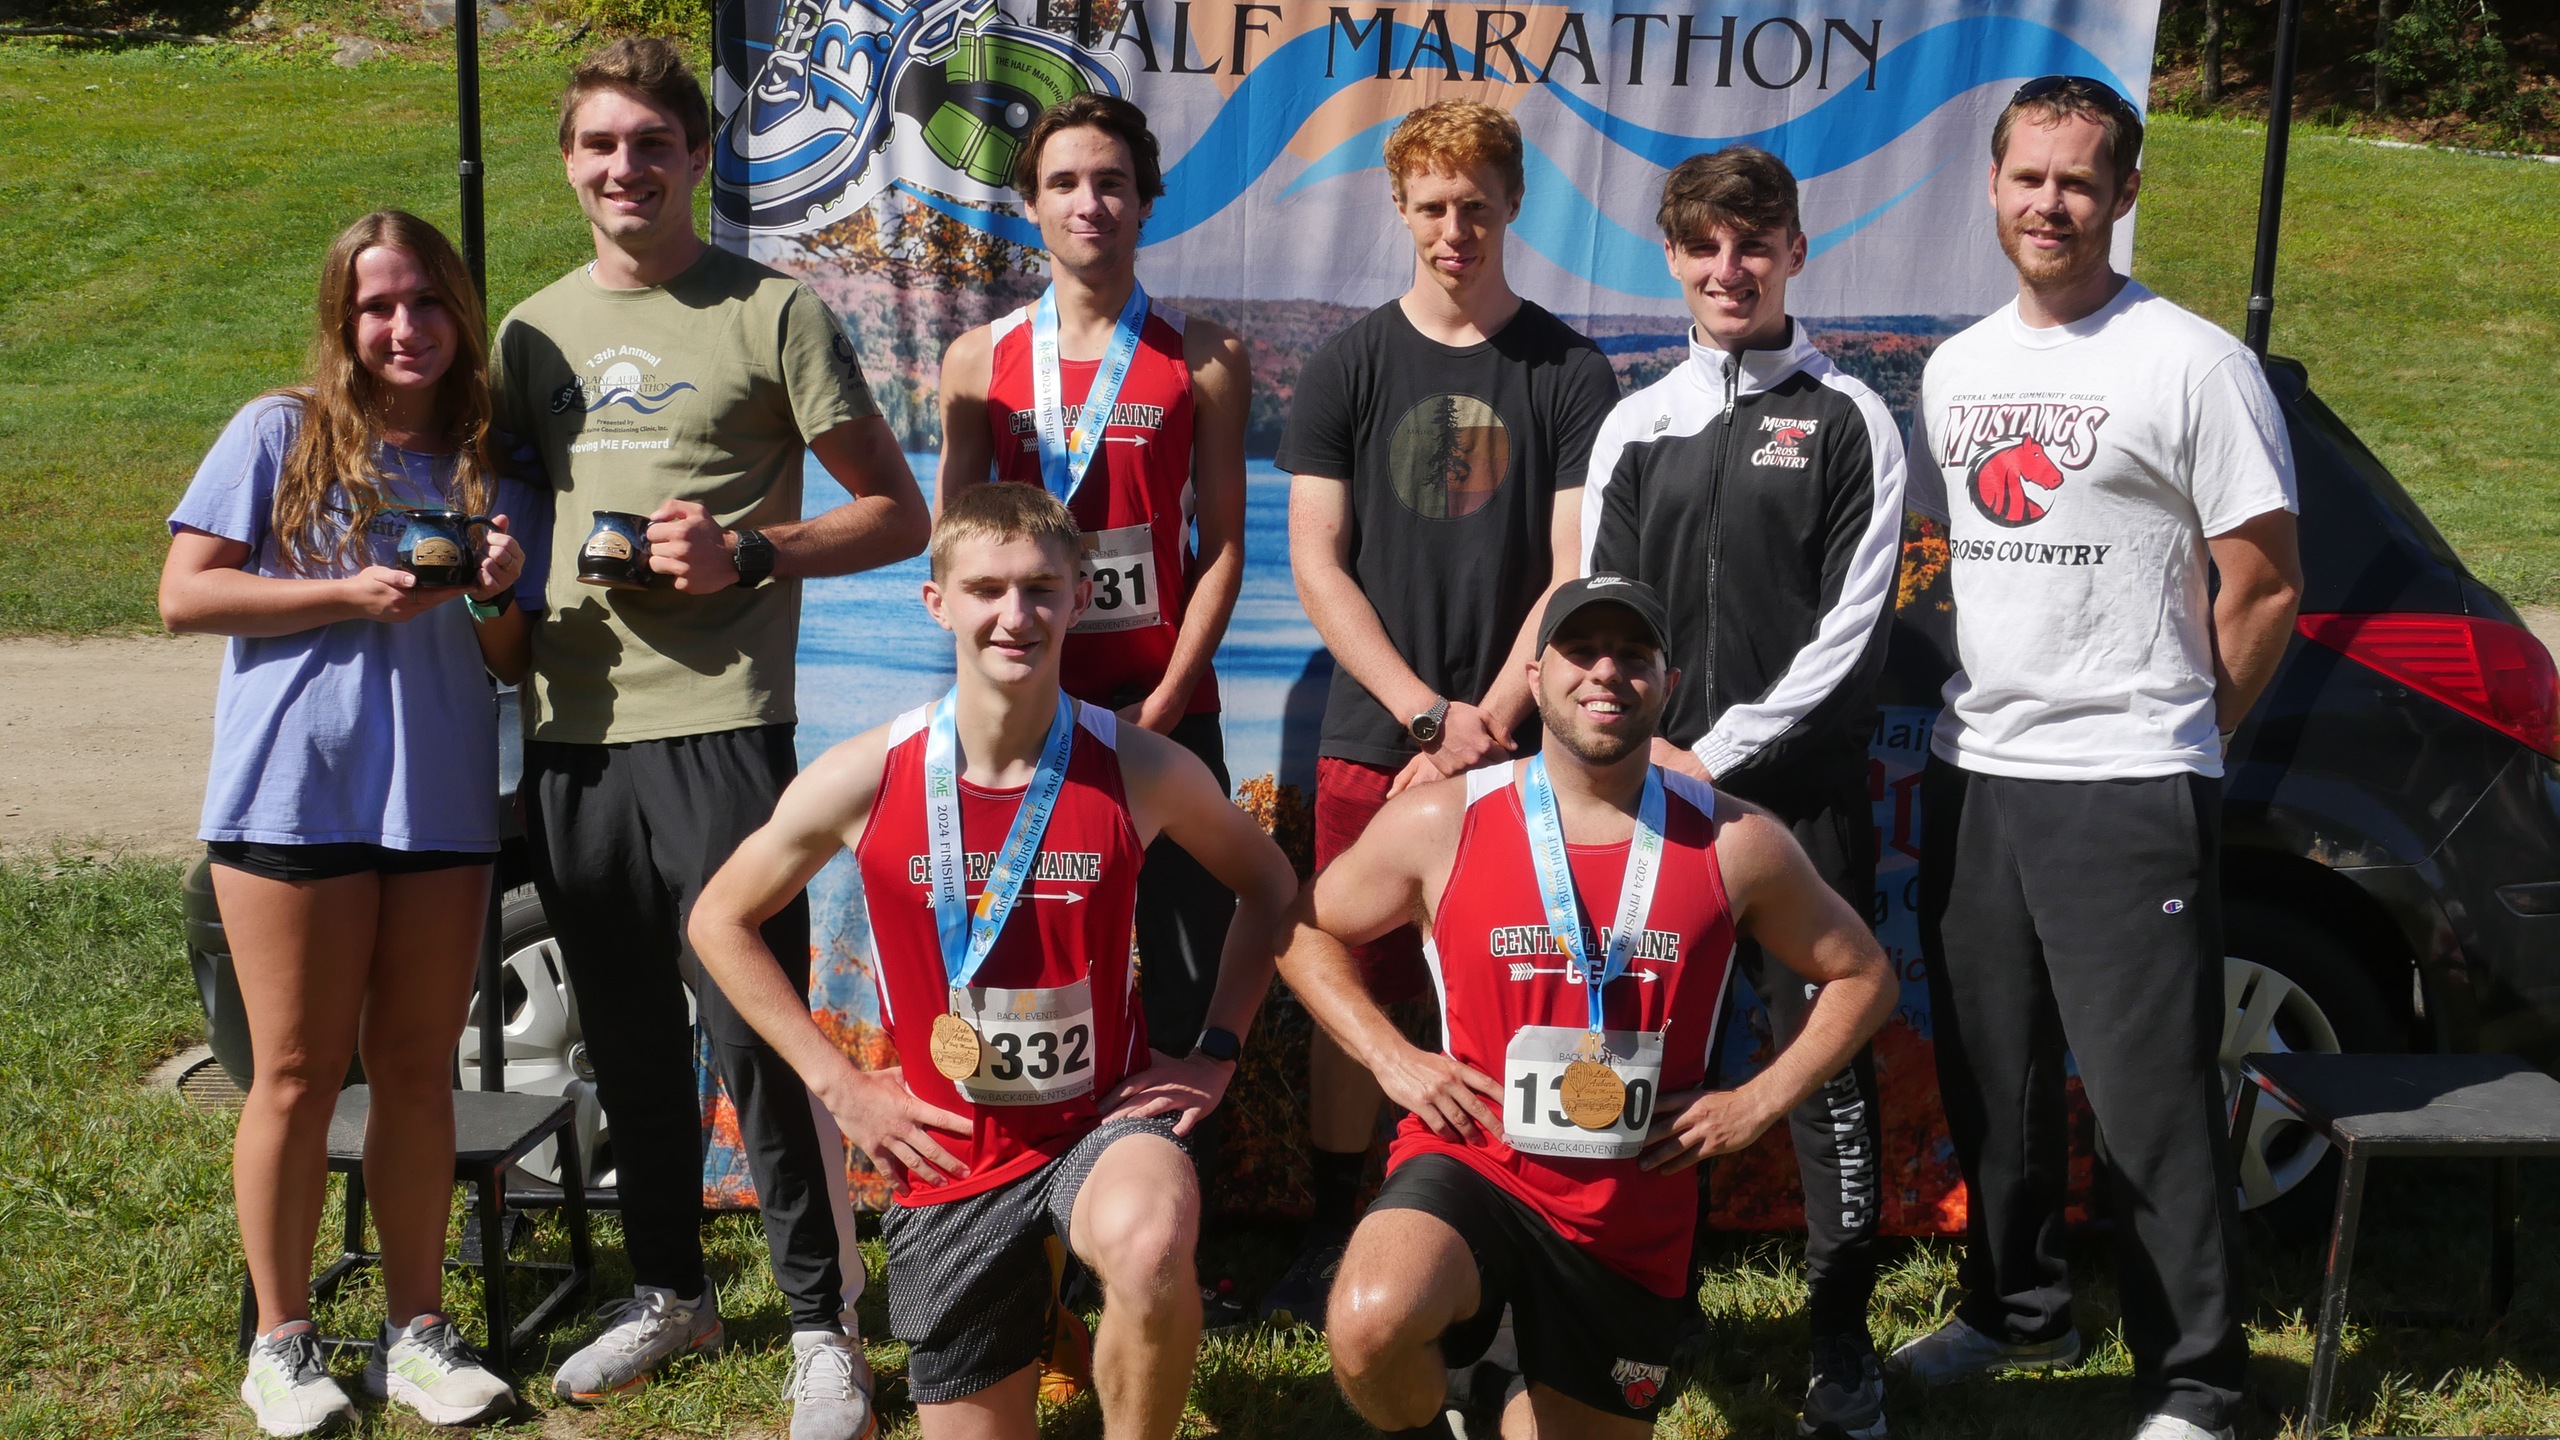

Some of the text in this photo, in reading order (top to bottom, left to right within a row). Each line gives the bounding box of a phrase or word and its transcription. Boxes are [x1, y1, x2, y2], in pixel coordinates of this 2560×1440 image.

[1036, 0, 1883, 91] HALF MARATHON
[995, 56, 1064, 102] THE HALF MARATHO
[585, 344, 662, 369] 13th Annual
[1093, 385, 1116, 426] AUBURN
[1109, 361, 1126, 386] HALF
[1120, 311, 1143, 359] MARATHON
[1041, 368, 1056, 445] 2024 FINISHER
[1952, 394, 1987, 402] CENTRAL
[1990, 392, 2016, 400] MAINE
[2069, 393, 2107, 402] COLLEGE
[601, 426, 639, 434] Conditioning
[1757, 415, 1819, 436] MUSTANGS
[1941, 403, 2111, 471] MUSTANGS
[567, 438, 670, 454] Moving ME Forward
[1764, 441, 1799, 456] CROSS
[1750, 449, 1809, 469] COUNTRY
[1090, 549, 1119, 558] EVENTS
[1950, 539, 2112, 566] ROSS COUNTRY
[1081, 562, 1147, 611] 31
[935, 775, 949, 798] ME
[991, 733, 1071, 924] LAKE AUBURN HALF MARATHON
[1006, 799, 1037, 860] Annual
[937, 804, 955, 904] 2024 FINISHER
[1641, 832, 1656, 855] ME
[1536, 768, 1583, 957] LAKE AUBURN HALF MARATHON
[1616, 858, 1649, 953] 2024 FINISHER
[997, 1010, 1059, 1021] BACK EVENTS
[955, 1025, 970, 1034] Lake
[1559, 1052, 1583, 1061] BACK
[1588, 1078, 1617, 1088] Auburn
[1593, 1069, 1613, 1078] Lake
[967, 1084, 1086, 1102] www.BACK40EVENTS.com
